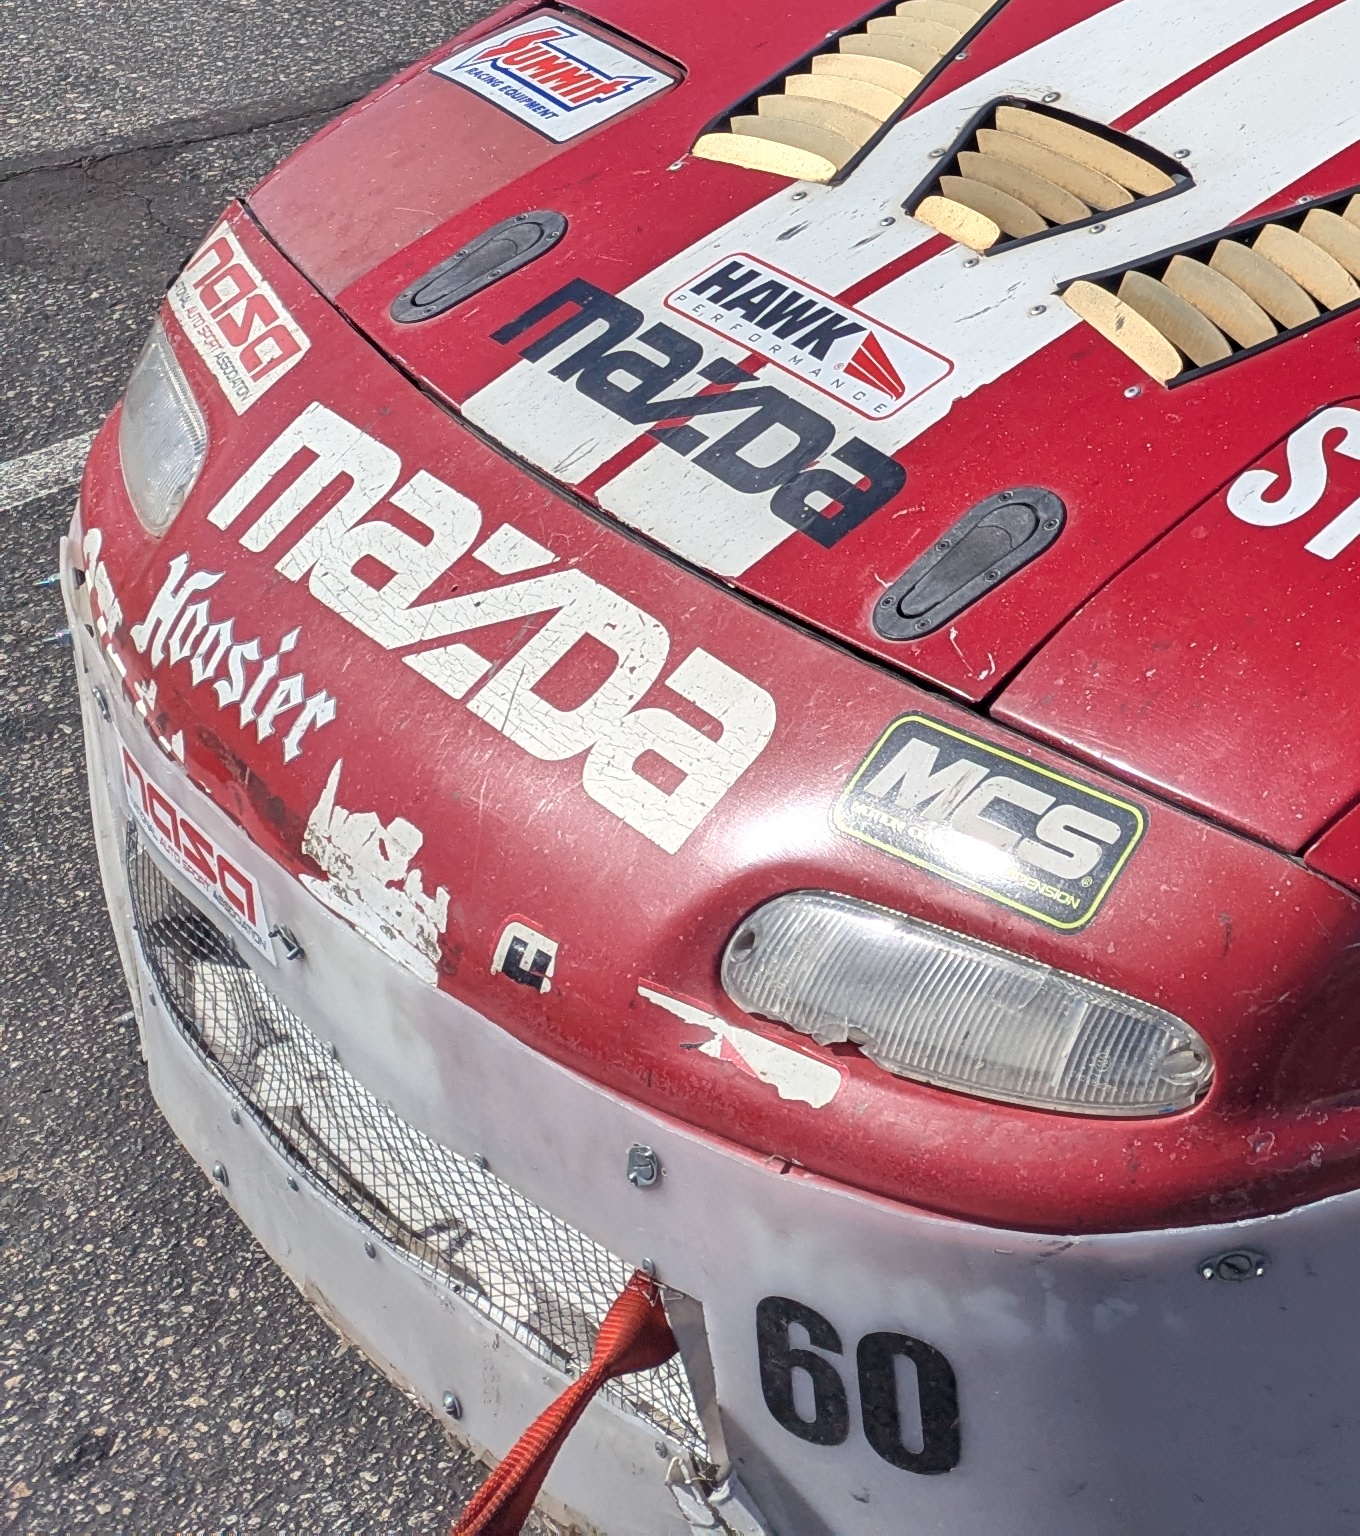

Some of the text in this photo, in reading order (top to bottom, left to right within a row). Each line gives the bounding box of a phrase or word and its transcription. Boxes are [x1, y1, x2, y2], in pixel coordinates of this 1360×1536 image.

[464, 66, 560, 121] RACING EQUIPMENT
[474, 28, 633, 105] SUMMIT
[185, 236, 303, 384] nasa
[186, 304, 205, 330] AUTO
[197, 324, 224, 354] SPORT
[213, 349, 253, 402] ASSOCIATION
[673, 294, 888, 414] PERFORMANCE
[689, 260, 868, 362] HAWK
[490, 276, 908, 550] mazda
[129, 550, 337, 766] Hoosier
[207, 400, 778, 856] mazda
[121, 745, 257, 928] nasa
[181, 857, 211, 892] SPORT
[863, 737, 1122, 880] MCS
[755, 1295, 962, 1476] 60
